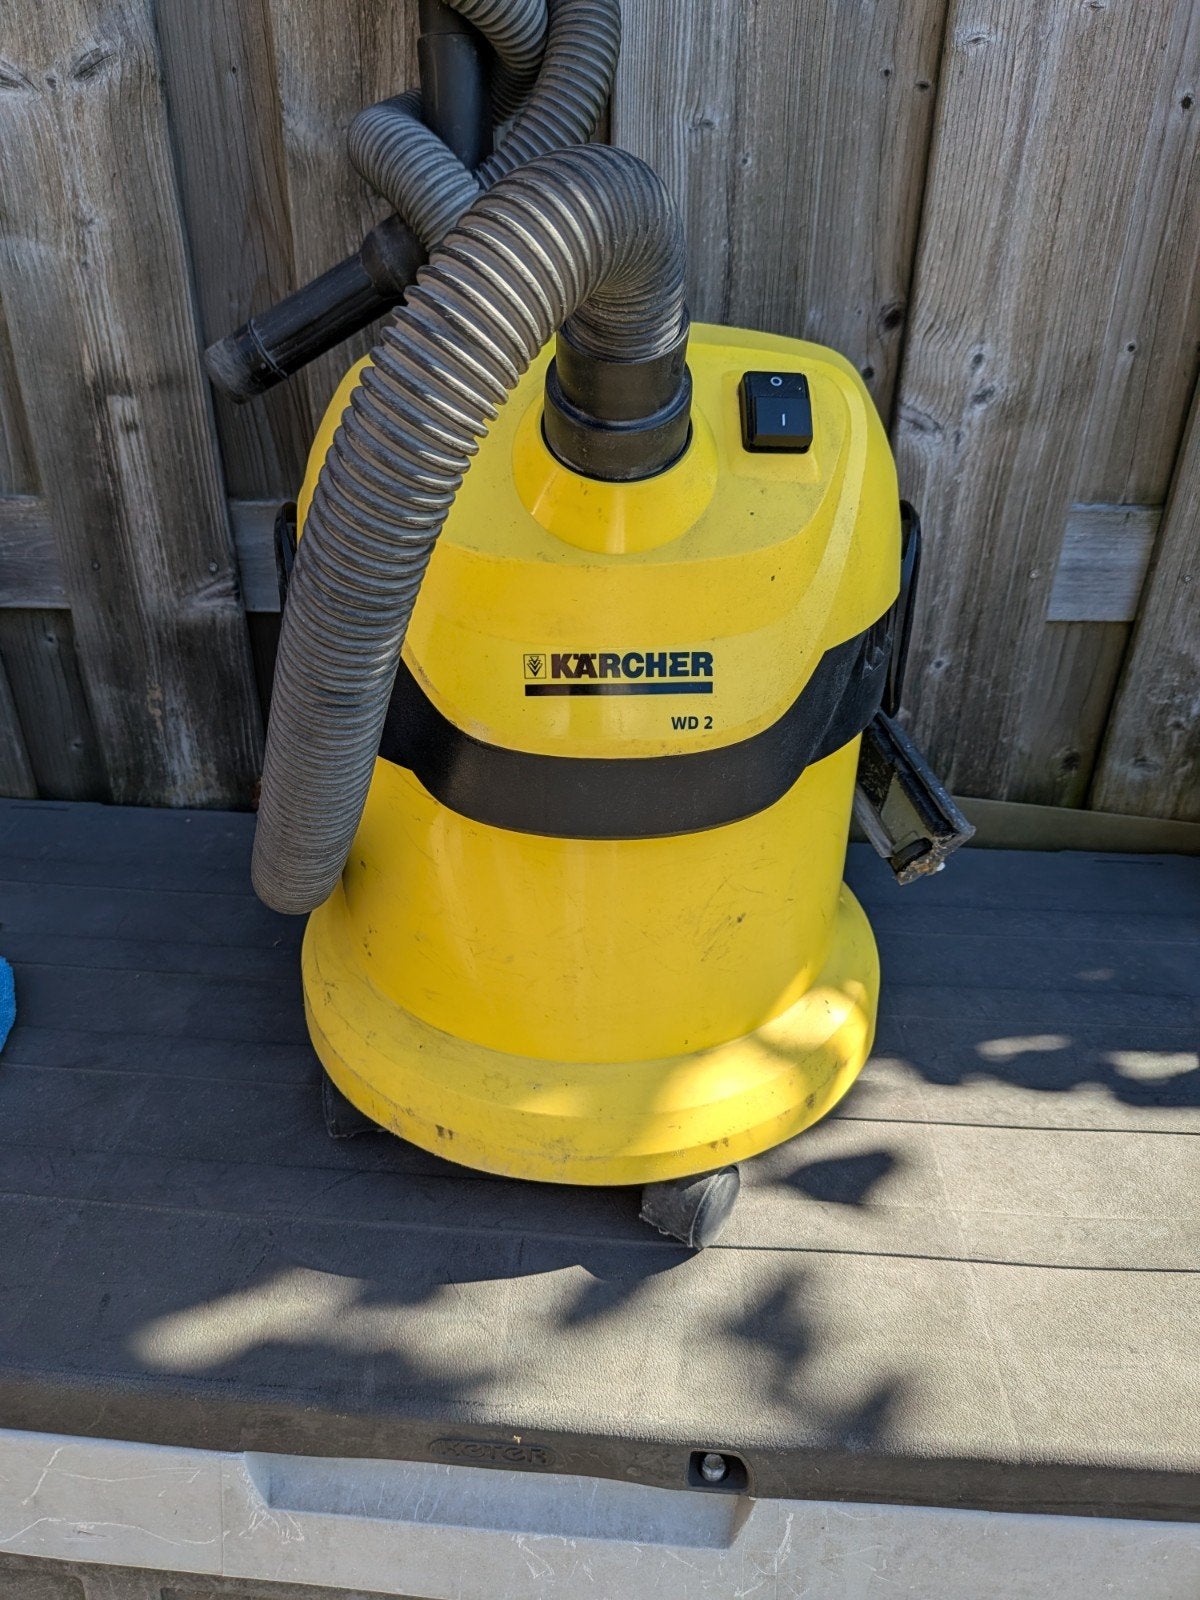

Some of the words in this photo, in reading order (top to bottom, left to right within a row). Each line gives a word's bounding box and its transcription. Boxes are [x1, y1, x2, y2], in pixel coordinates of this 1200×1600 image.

[551, 652, 714, 679] KÄRCHER
[671, 716, 699, 730] WD
[703, 716, 713, 730] 2
